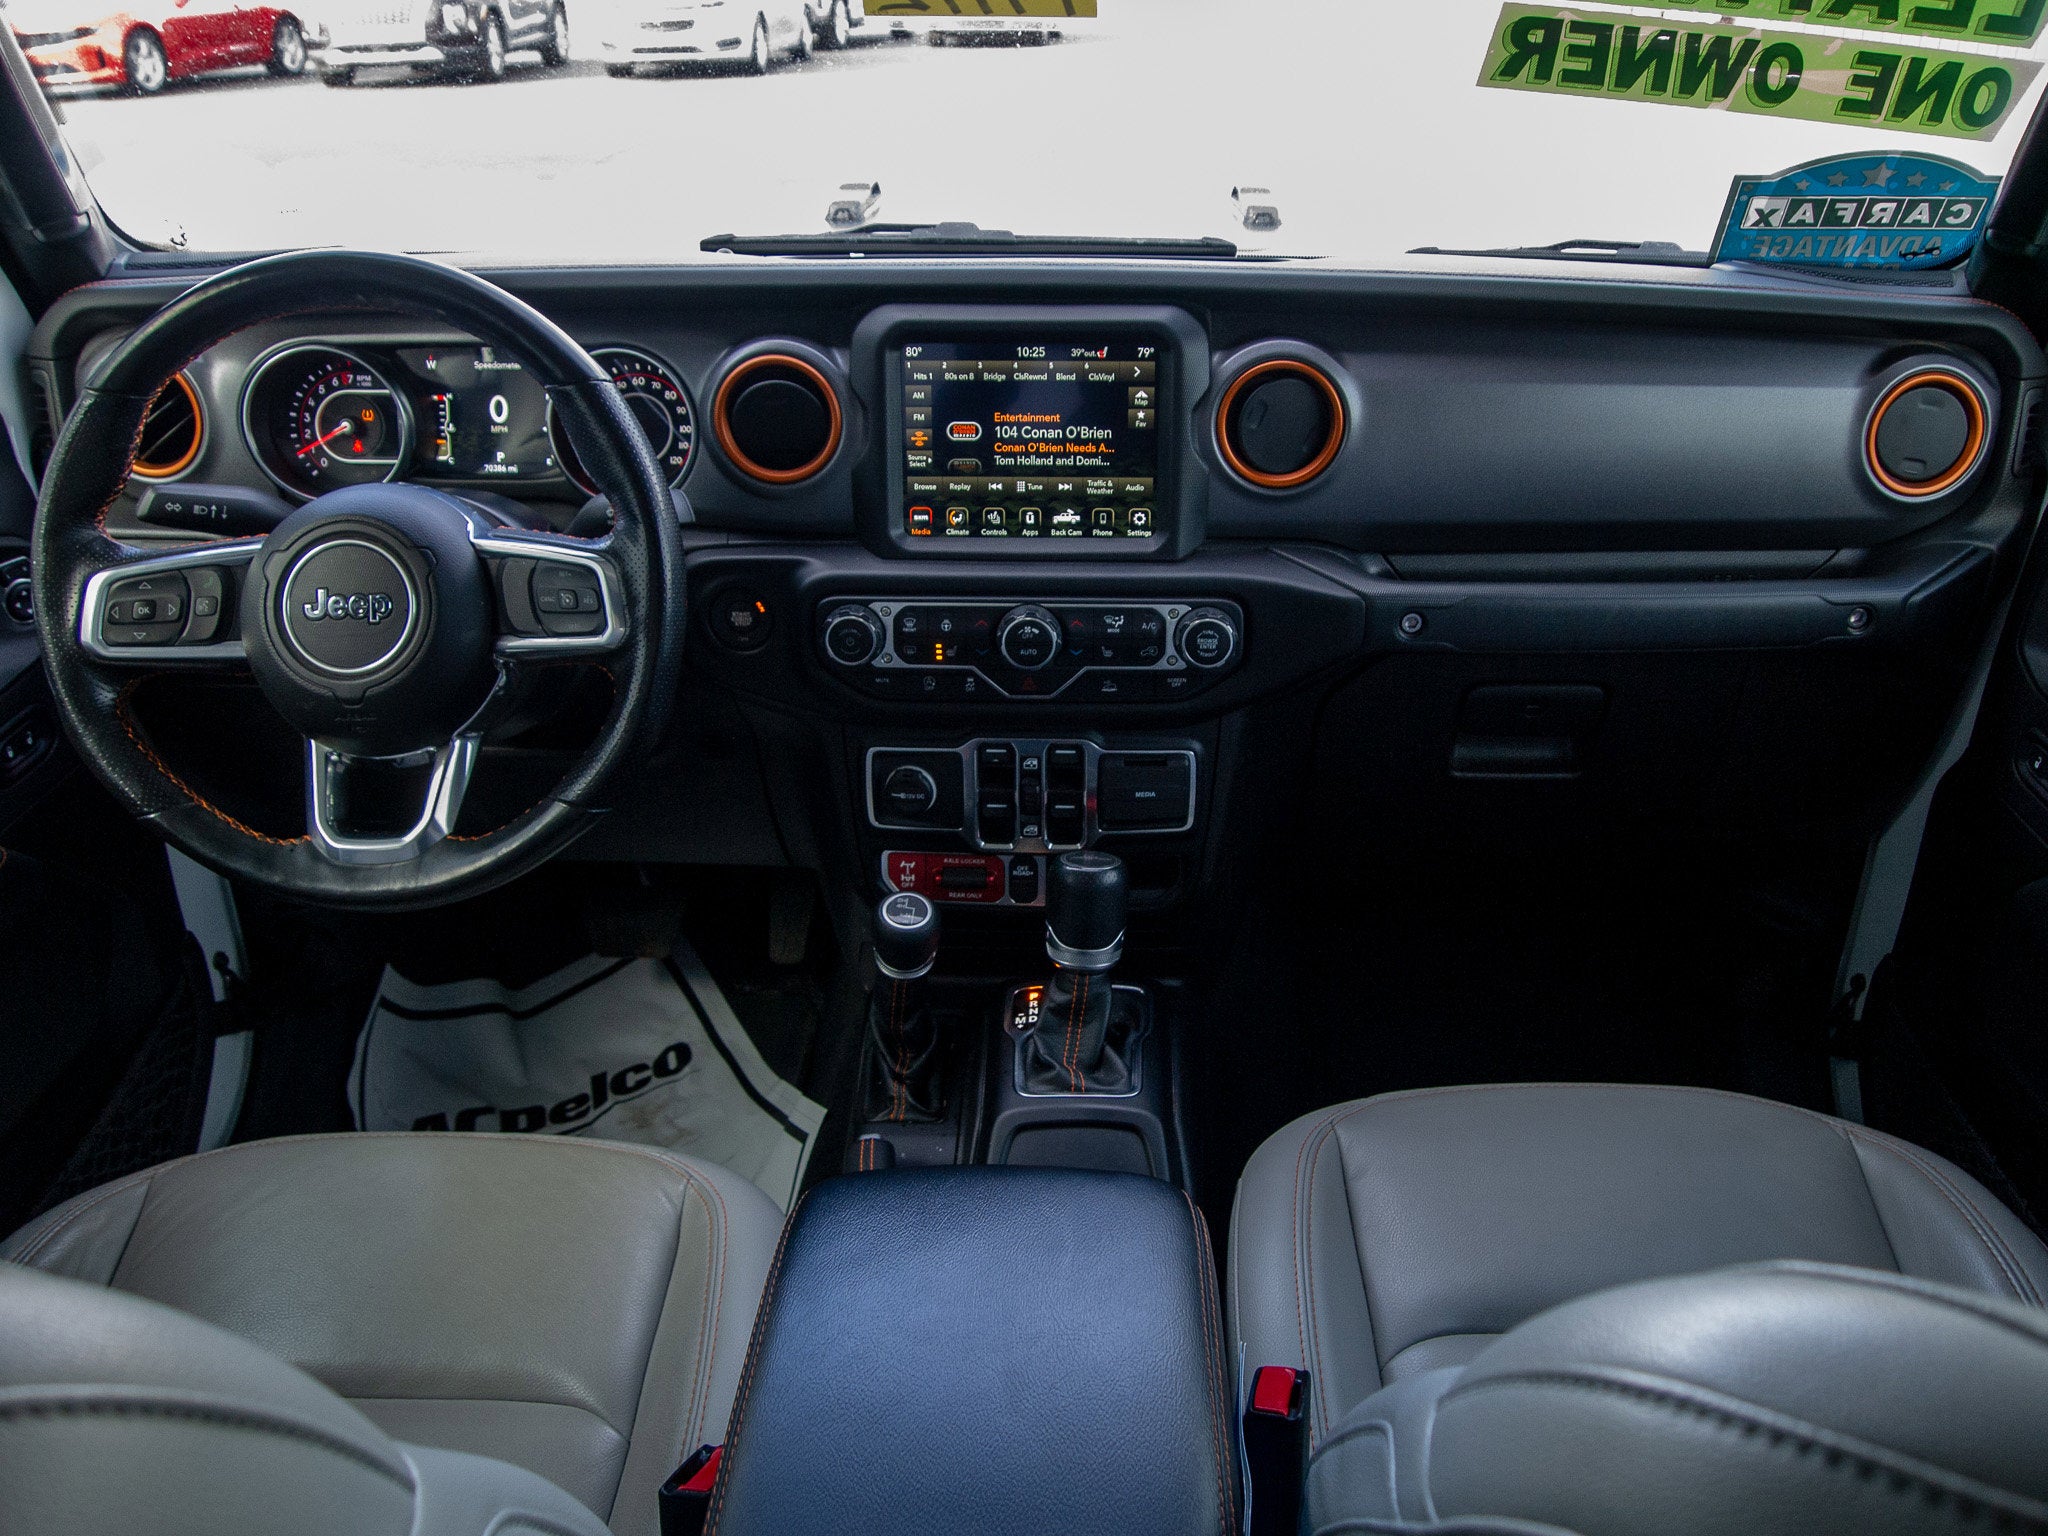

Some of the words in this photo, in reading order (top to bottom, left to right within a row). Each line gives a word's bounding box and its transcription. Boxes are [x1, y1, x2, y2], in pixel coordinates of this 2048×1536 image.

[1016, 346, 1045, 357] 10:25
[425, 359, 437, 370] W
[356, 374, 372, 382] RPM
[913, 372, 927, 380] Hits
[944, 372, 957, 380] 80s
[969, 372, 975, 380] 8
[983, 372, 1006, 382] Bridge
[1013, 372, 1048, 380] ClsRewnd
[1056, 372, 1076, 380] Blend
[1088, 372, 1115, 382] ClsVinyl
[332, 376, 339, 387] 6
[616, 380, 627, 389] 50
[632, 376, 646, 386] 60
[651, 381, 661, 390] 70
[318, 384, 326, 394] 5
[664, 390, 678, 400] 80
[912, 391, 925, 399] AM
[307, 396, 315, 407] 4
[1134, 398, 1149, 406] Map
[489, 394, 509, 424] 0
[676, 406, 687, 415] 90
[303, 412, 311, 423] 3
[913, 413, 925, 421] FM
[994, 412, 1061, 422] Entertainment
[304, 428, 311, 439] 2
[490, 425, 509, 433] MPH
[679, 425, 692, 433] 100
[994, 425, 1018, 439] 104
[1021, 425, 1063, 439] Conan
[1066, 425, 1112, 439] O'Brien
[678, 441, 689, 450] 110
[994, 442, 1025, 453] Conan
[1028, 442, 1063, 453] O'Brien
[1066, 442, 1097, 453] Needs
[496, 451, 506, 462] P
[669, 456, 683, 465] 120
[994, 455, 1015, 466] Tom
[1017, 455, 1053, 466] Holland
[1055, 455, 1074, 466] and
[320, 457, 328, 467] 0
[507, 464, 518, 473] mi
[913, 482, 937, 490] Browse
[949, 482, 972, 491] Replay
[1087, 479, 1106, 487] Traffic
[1086, 487, 1114, 495] Weather
[981, 528, 1008, 536] Controls
[1022, 529, 1039, 537] Apps
[1051, 529, 1067, 537] Back
[1067, 529, 1083, 537] Cam
[1092, 529, 1113, 537] Phone
[1127, 529, 1152, 537] Settings
[302, 587, 393, 625] Jeep
[138, 607, 150, 615] OK
[1141, 622, 1157, 630] A/C
[1019, 648, 1038, 656] AUTO
[1029, 992, 1039, 1001] P
[1029, 1000, 1039, 1008] R
[1028, 1007, 1039, 1016] N
[1014, 1016, 1027, 1026] M
[1028, 1015, 1039, 1024] D
